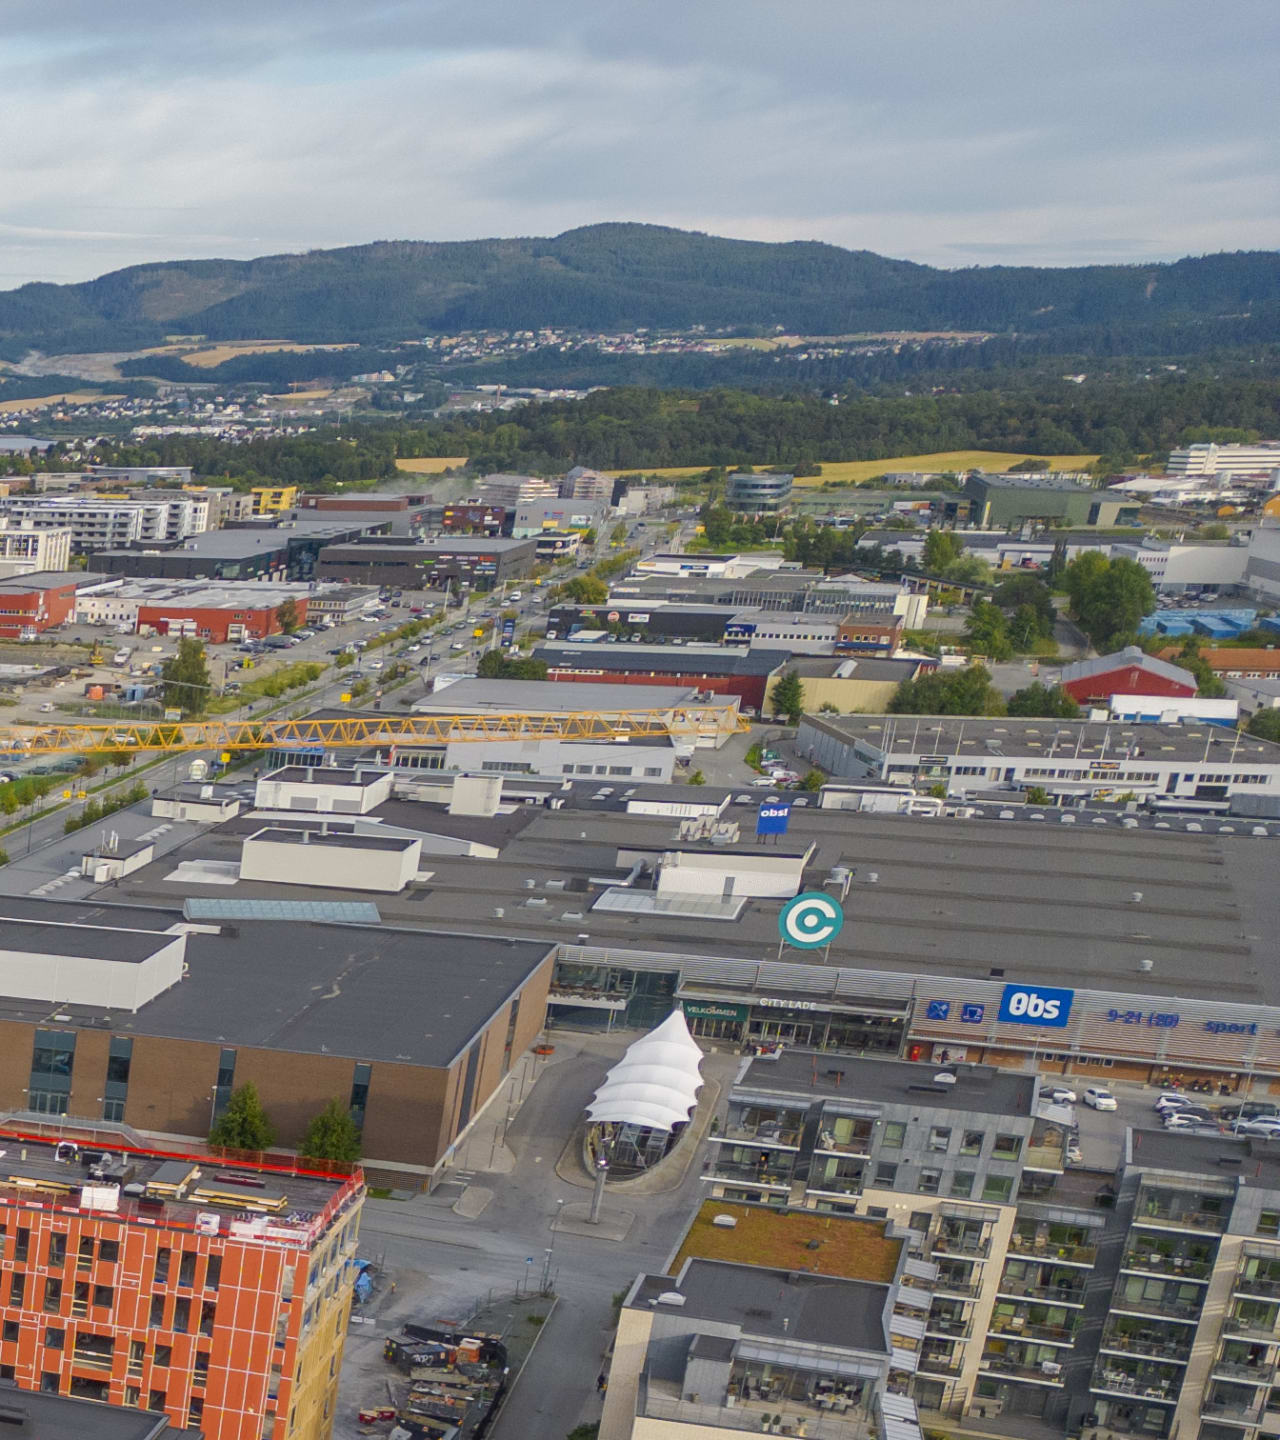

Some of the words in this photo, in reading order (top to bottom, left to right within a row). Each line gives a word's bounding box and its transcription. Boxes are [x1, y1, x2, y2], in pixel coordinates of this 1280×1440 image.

[759, 998, 787, 1008] CITY
[788, 1000, 817, 1010] LADE
[687, 1006, 737, 1016] VELKOMMEN
[1205, 1020, 1258, 1035] sport
